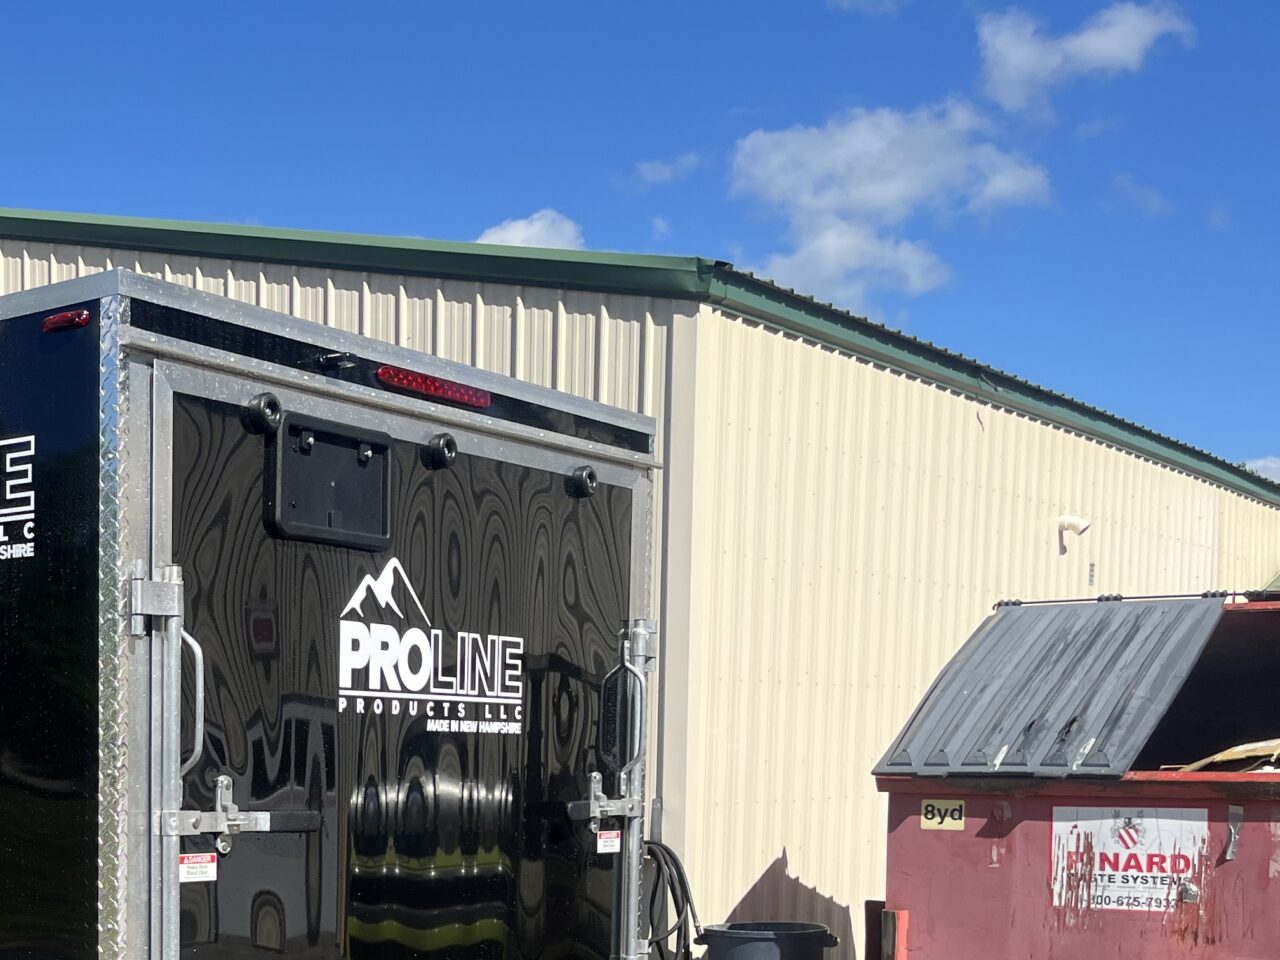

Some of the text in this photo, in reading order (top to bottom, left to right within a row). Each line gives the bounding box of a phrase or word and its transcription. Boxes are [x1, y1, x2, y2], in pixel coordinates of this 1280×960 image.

[339, 620, 523, 697] PROLINE
[338, 698, 522, 720] PRODUCTS LLC
[426, 719, 522, 734] MADE IN NEW HAMPSHIRE
[924, 804, 963, 825] 8yd
[1066, 851, 1191, 874] PNARD
